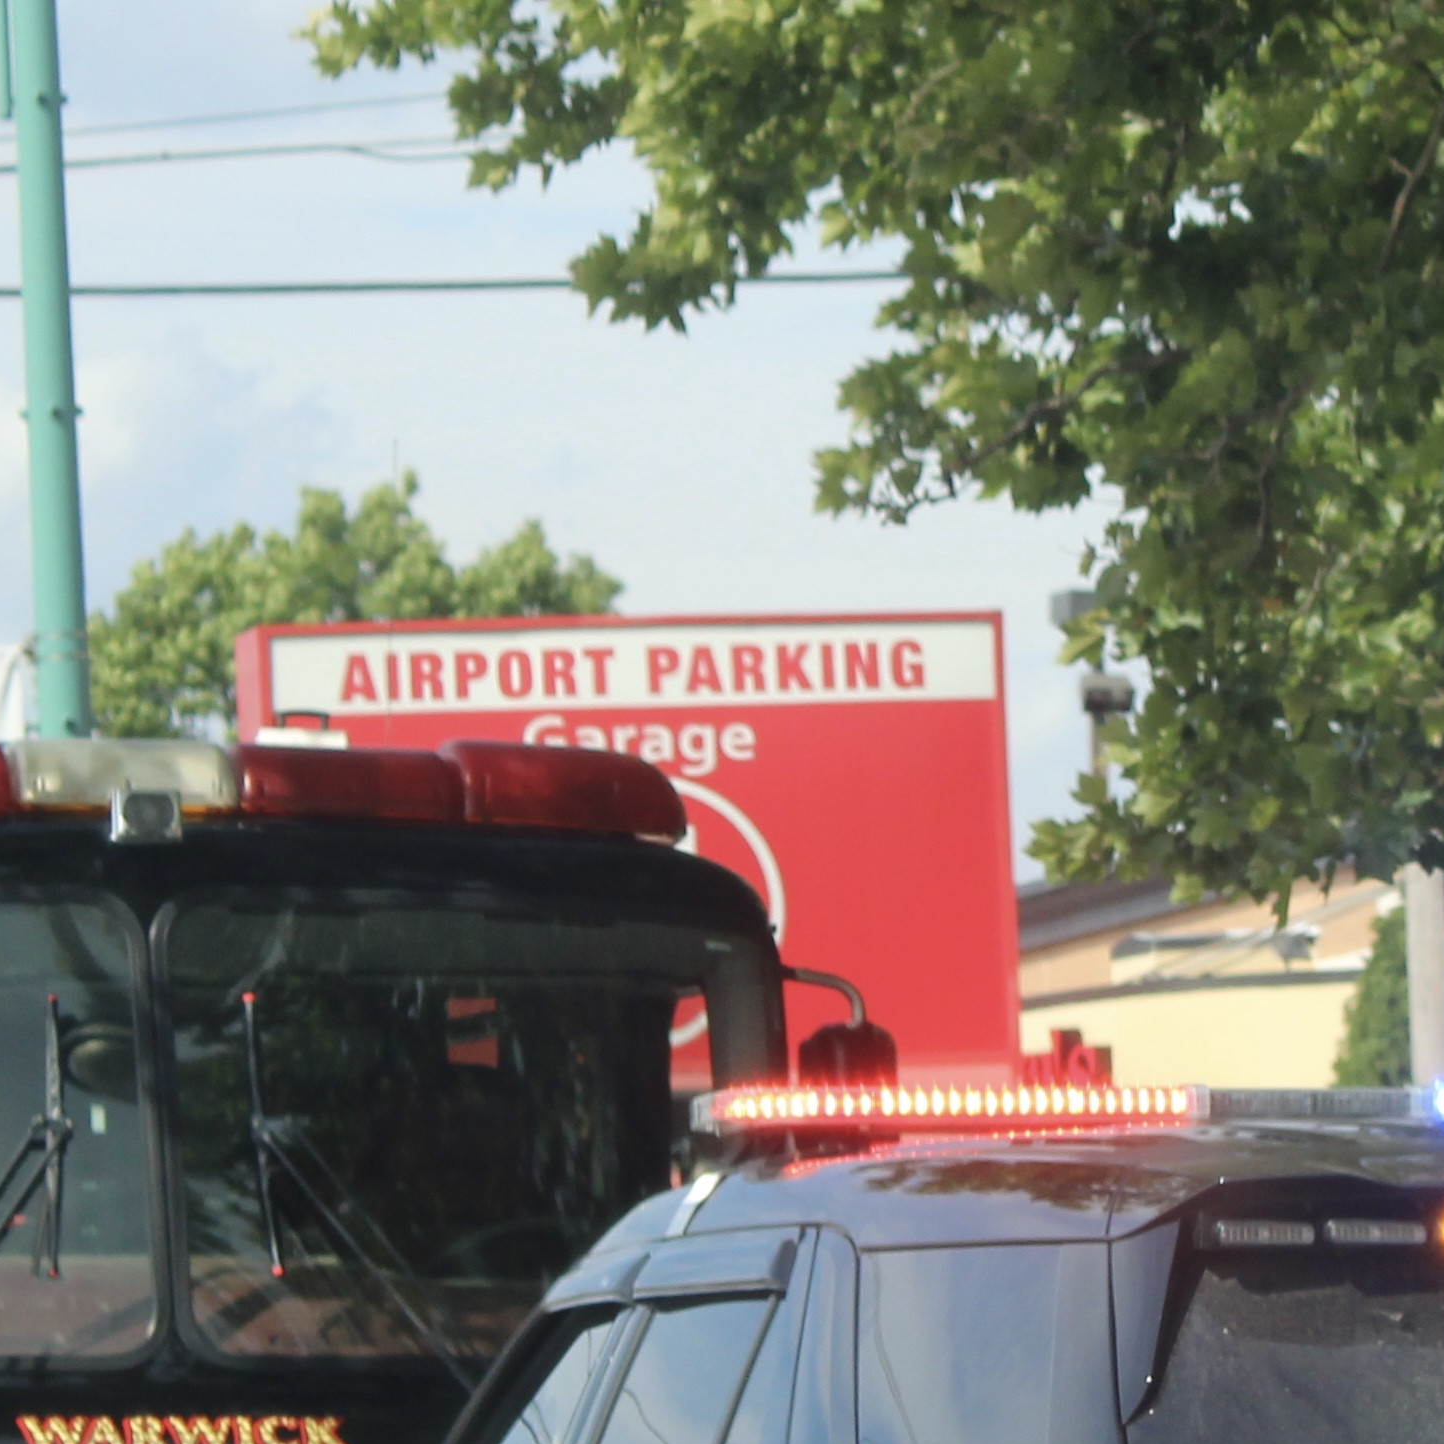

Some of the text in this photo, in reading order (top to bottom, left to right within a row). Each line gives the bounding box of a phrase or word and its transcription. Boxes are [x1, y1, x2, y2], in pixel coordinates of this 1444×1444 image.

[340, 640, 927, 703] AIRPORT PARKING
[522, 713, 758, 778] Garage
